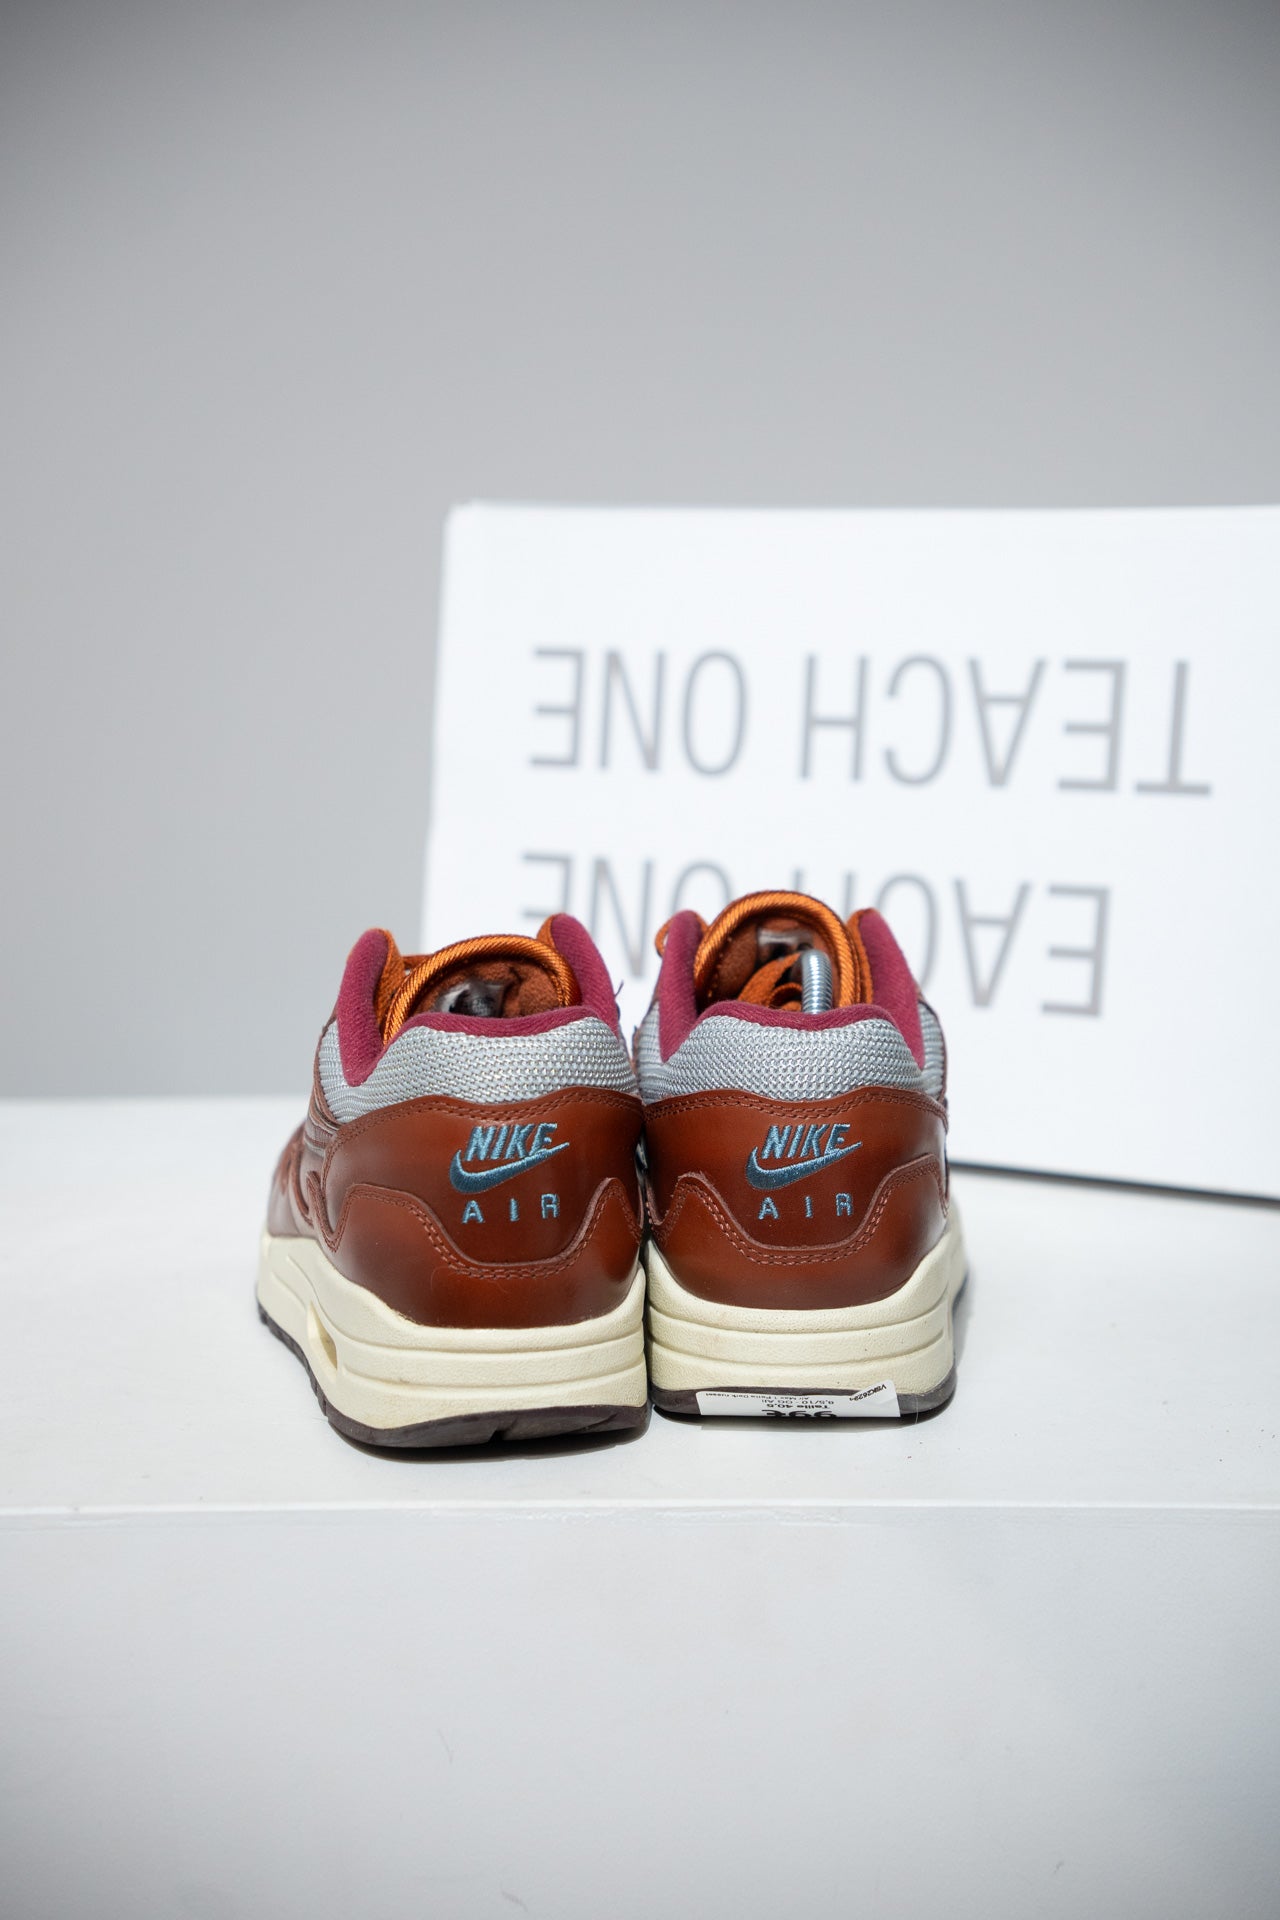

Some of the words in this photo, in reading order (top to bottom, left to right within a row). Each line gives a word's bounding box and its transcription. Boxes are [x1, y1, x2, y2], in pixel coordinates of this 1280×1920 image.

[529, 645, 749, 778] ONE
[799, 652, 1213, 797] TEACH
[792, 867, 1111, 1020] EAC
[464, 1123, 557, 1161] NIKE
[761, 1123, 851, 1159] NIKE
[462, 1193, 559, 1224] AIR
[758, 1192, 853, 1220] AIR
